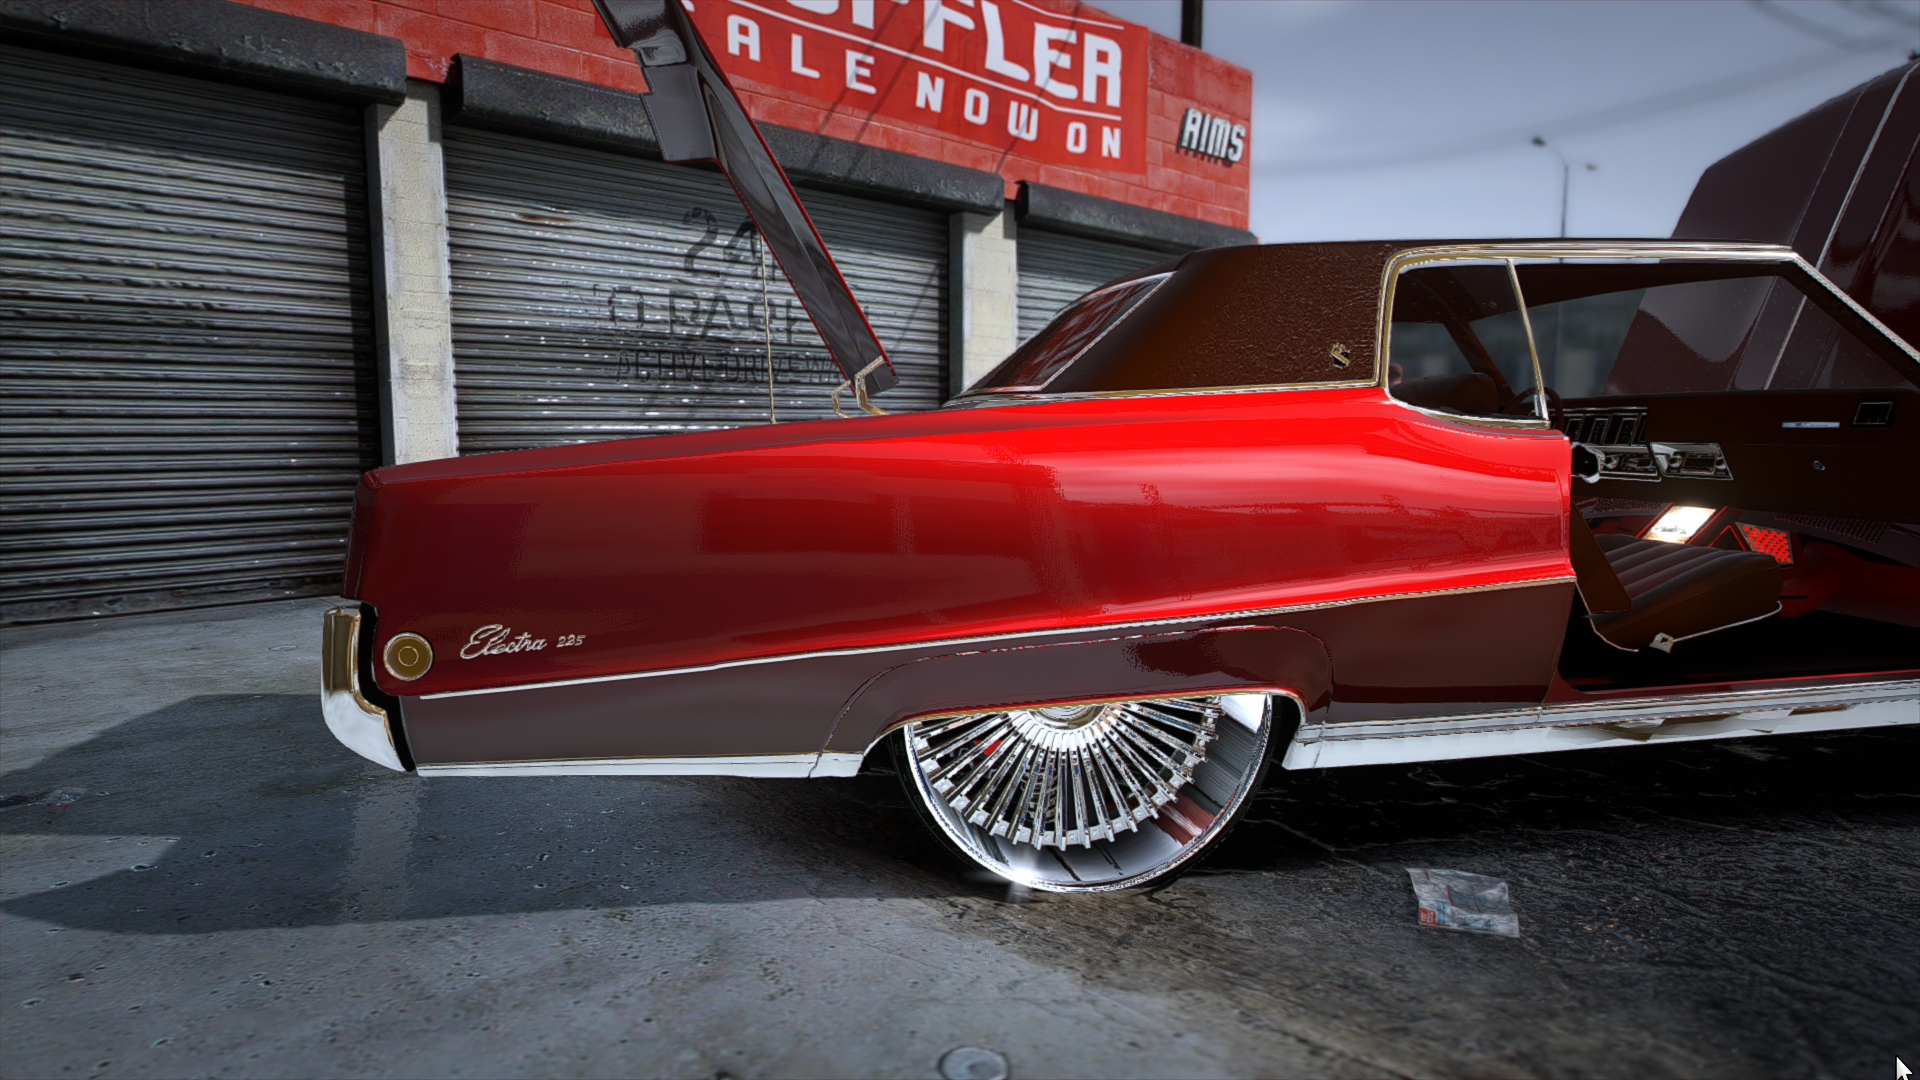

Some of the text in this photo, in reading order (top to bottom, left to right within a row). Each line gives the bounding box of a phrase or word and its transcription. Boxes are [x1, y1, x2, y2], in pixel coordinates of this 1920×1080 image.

[681, 0, 1121, 159] ALE NOW ON
[787, 0, 1122, 108] FLER
[1180, 107, 1246, 162] AIMS
[460, 624, 587, 659] Electra 225
